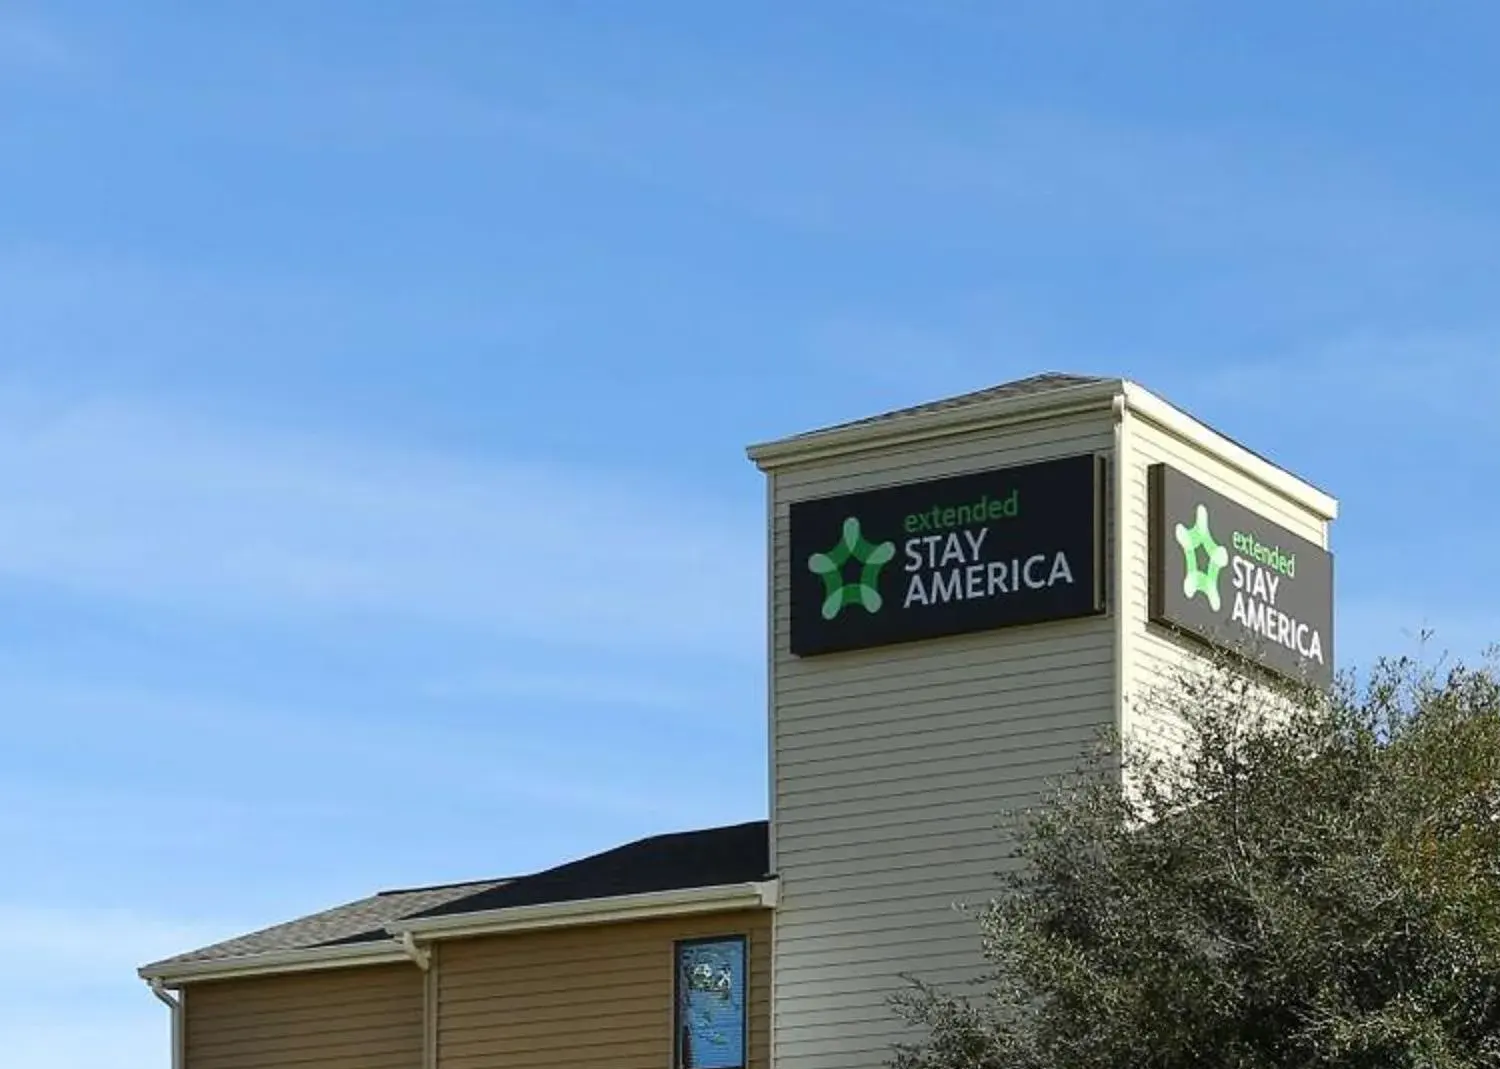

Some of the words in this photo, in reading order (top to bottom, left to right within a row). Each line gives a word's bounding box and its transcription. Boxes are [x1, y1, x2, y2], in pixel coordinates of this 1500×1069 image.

[904, 490, 1018, 533] extended
[904, 527, 988, 571] STAY
[1231, 531, 1296, 579] extended
[903, 551, 1074, 608] AMERICA
[1231, 555, 1280, 604] STAY
[1231, 591, 1324, 665] AMERICA
